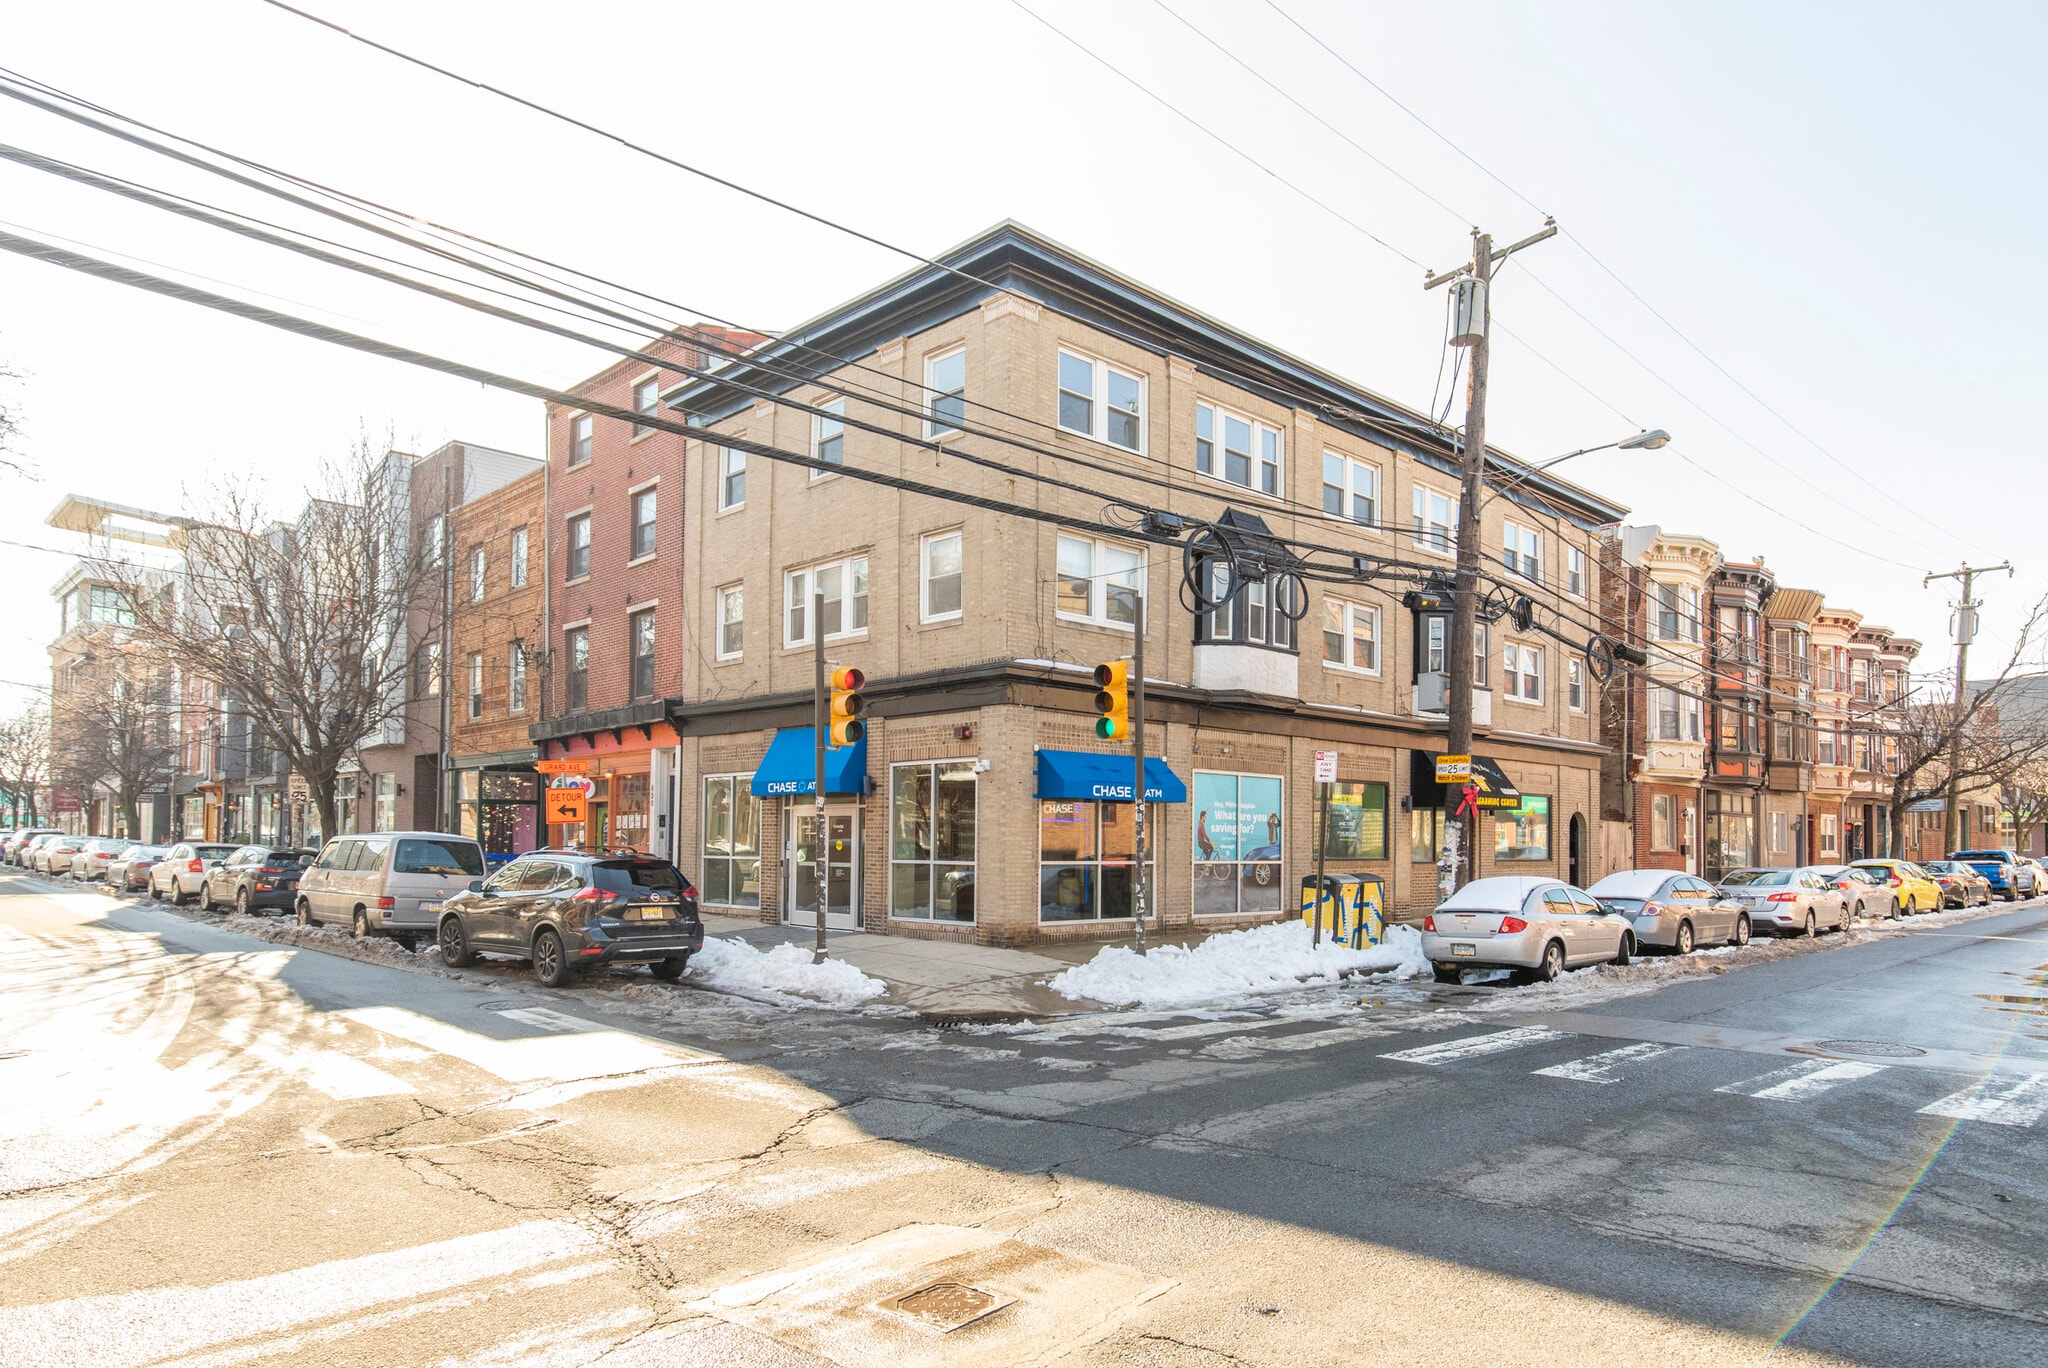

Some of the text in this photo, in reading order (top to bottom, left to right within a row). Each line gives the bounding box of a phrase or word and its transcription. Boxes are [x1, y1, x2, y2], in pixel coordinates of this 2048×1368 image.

[1448, 765, 1457, 773] 25
[767, 782, 816, 793] CHASE AT
[1093, 785, 1162, 798] CHASE ATM
[291, 791, 307, 802] 25
[550, 793, 582, 802] DETOUR
[1501, 798, 1517, 807] CENTER
[1043, 804, 1073, 814] CHASE
[1214, 810, 1236, 820] What
[1252, 814, 1267, 824] you
[1210, 823, 1236, 835] saving
